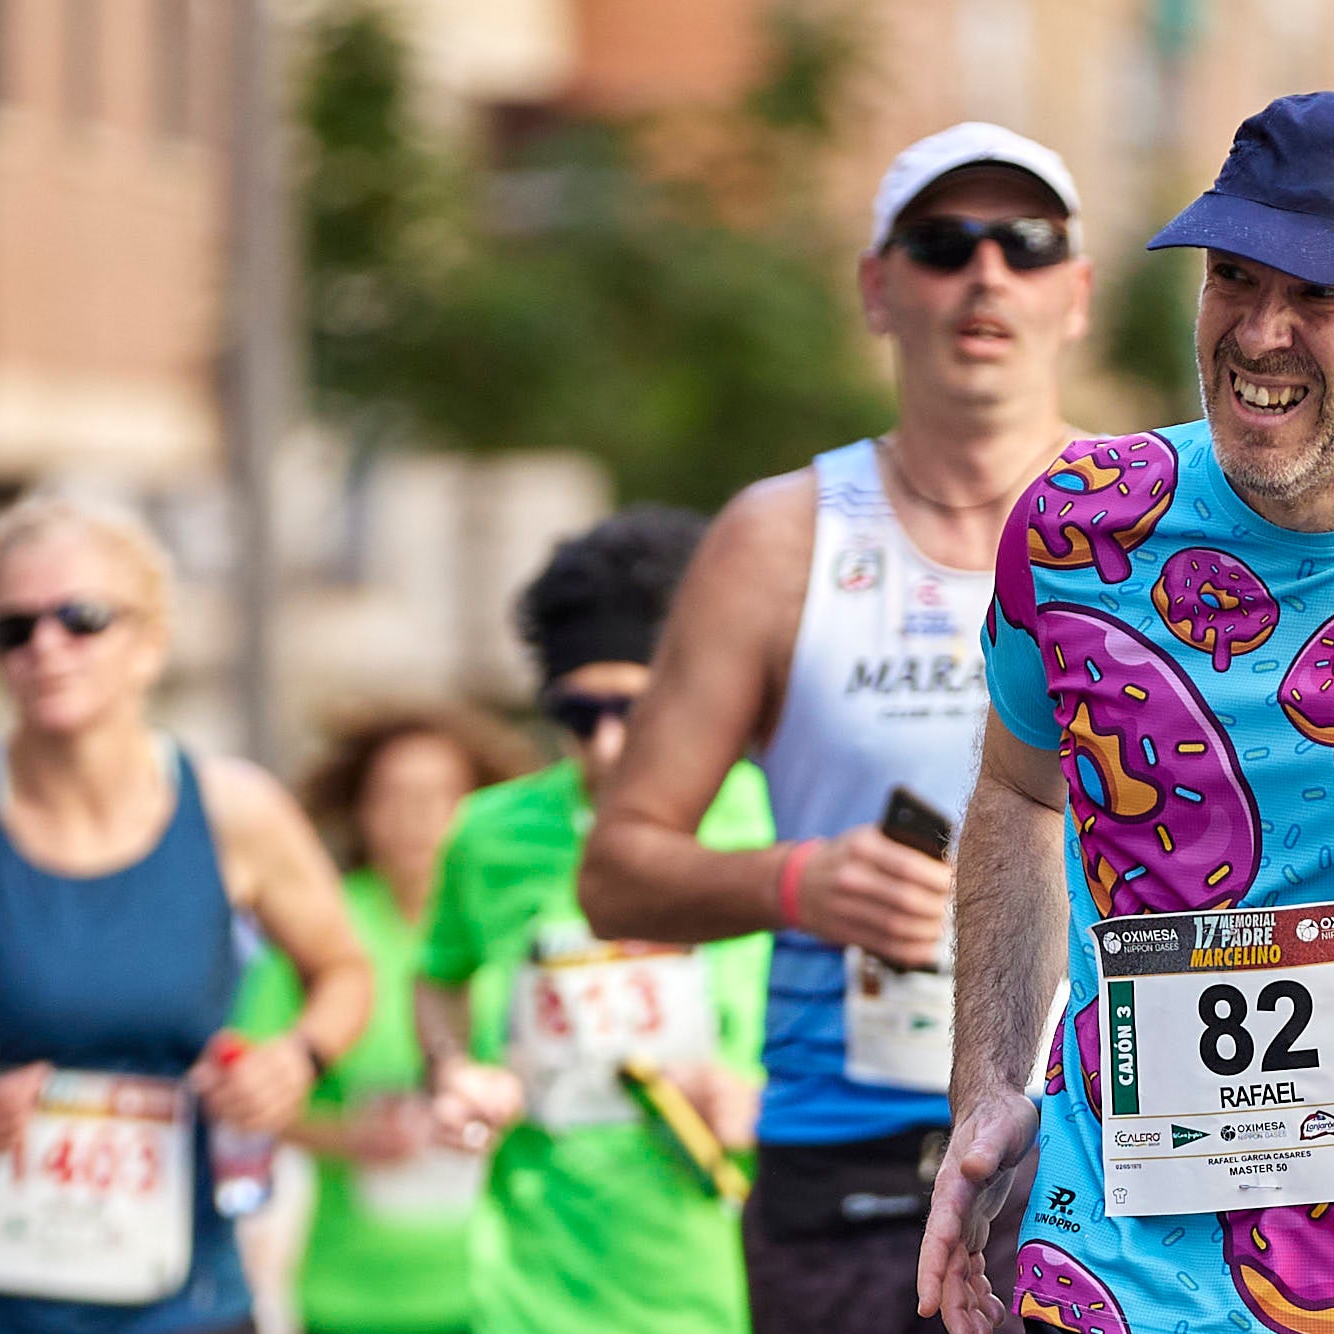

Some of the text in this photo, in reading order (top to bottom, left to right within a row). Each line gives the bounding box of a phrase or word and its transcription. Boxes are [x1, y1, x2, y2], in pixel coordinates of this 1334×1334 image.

[1219, 913, 1276, 929] MEMORIAL
[1122, 929, 1179, 943] OXIMESA
[1194, 916, 1220, 949] 17
[1221, 927, 1273, 948] PADRE
[1124, 943, 1179, 953] NIPPON GASES
[1190, 945, 1281, 967] MARCELINO
[1198, 980, 1320, 1076] 82
[1114, 1005, 1134, 1086] CAJÓN 3
[1220, 1082, 1305, 1108] RAFAEL
[1237, 1121, 1286, 1132] OXIMESA
[1118, 1132, 1161, 1143] CALERO
[1208, 1150, 1312, 1165] RAFAEL GARCIA CASARES
[1229, 1163, 1288, 1176] MASTER 50
